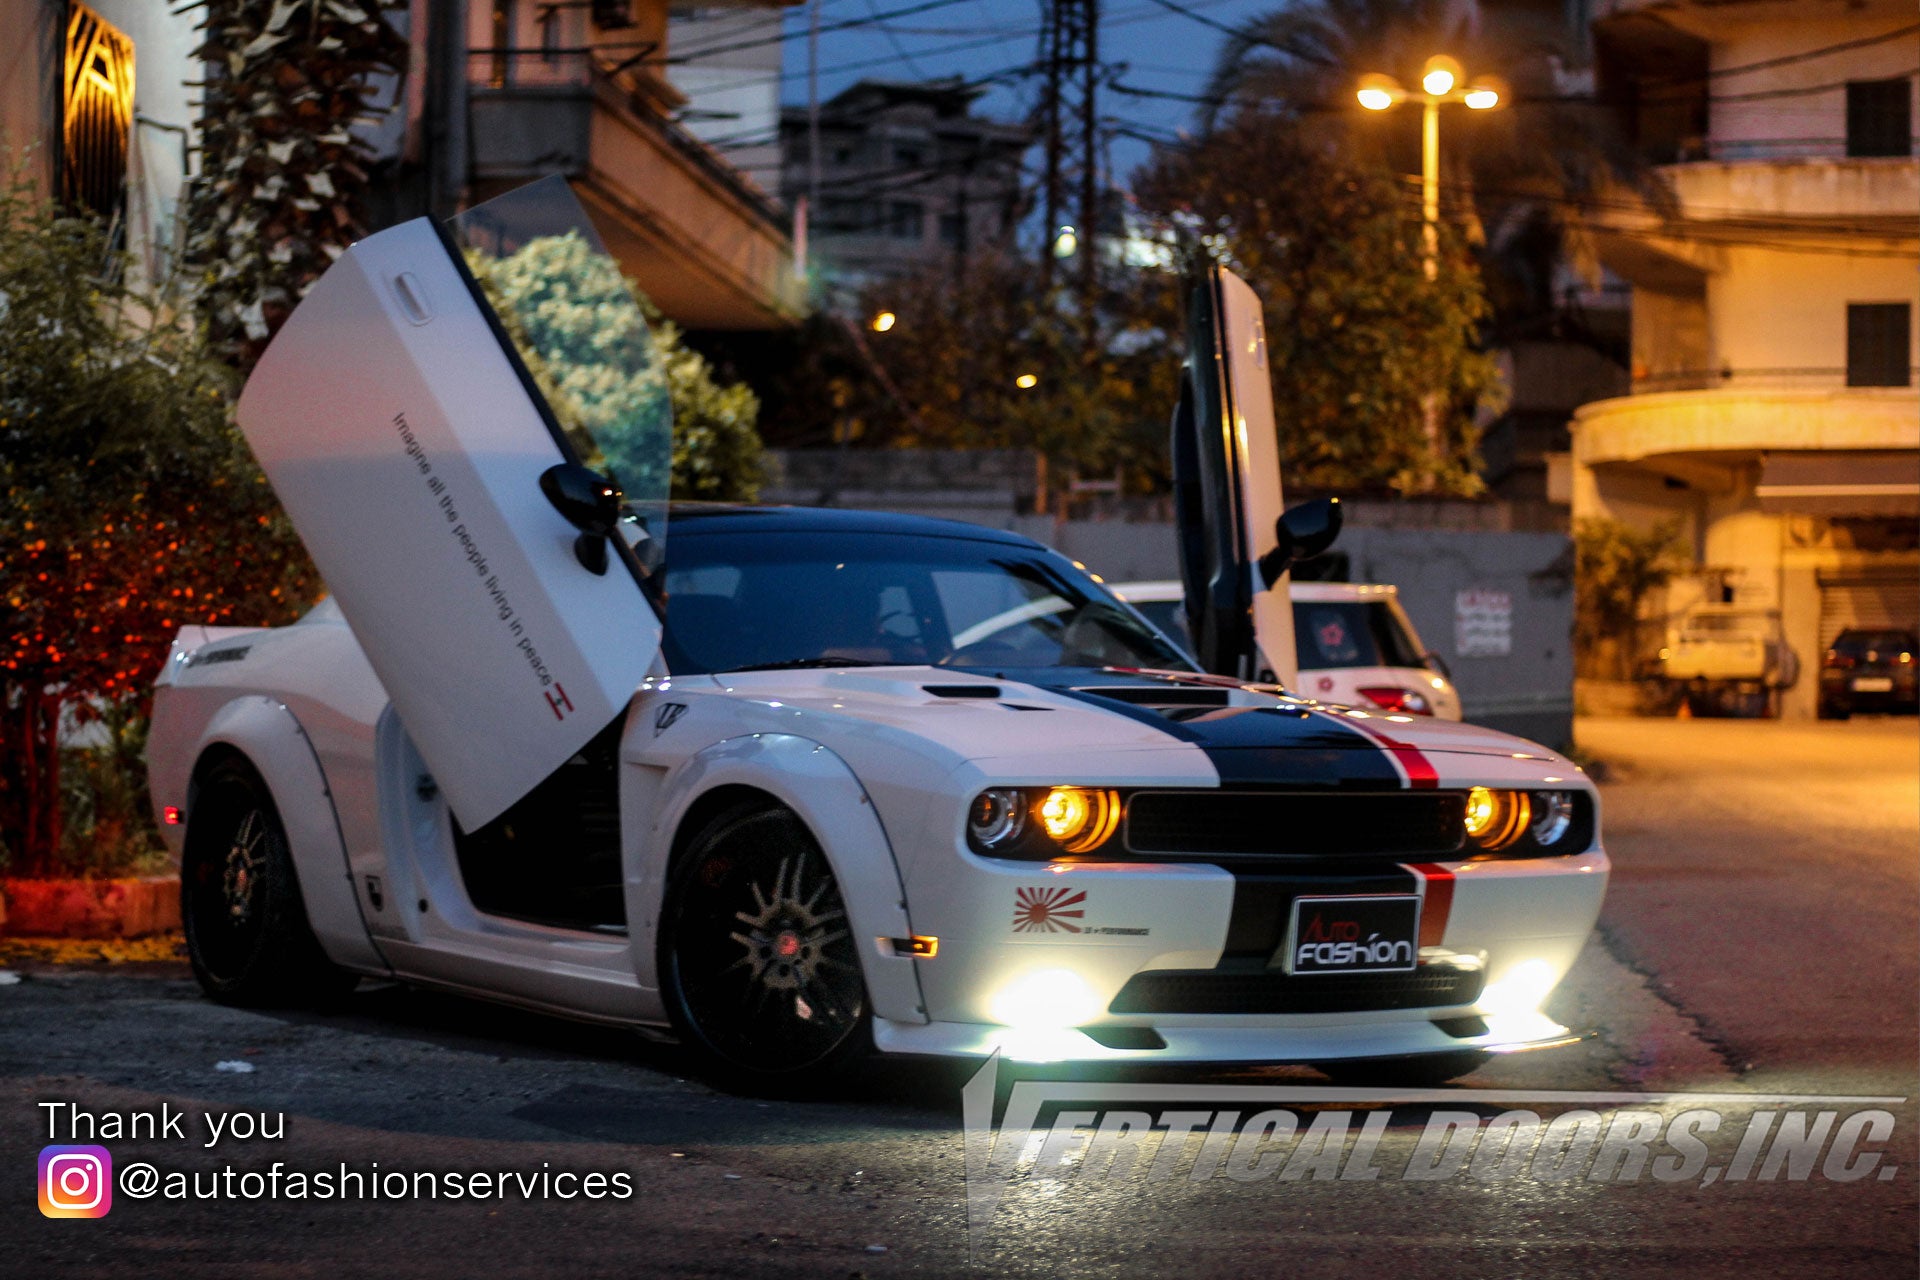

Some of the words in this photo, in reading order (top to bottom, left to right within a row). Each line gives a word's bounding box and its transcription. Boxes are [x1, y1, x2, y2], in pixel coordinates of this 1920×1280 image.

[393, 412, 430, 475] Imagine
[427, 476, 446, 497] all
[438, 494, 458, 523] the
[452, 524, 489, 577] people
[484, 575, 513, 621] living
[509, 618, 523, 637] in
[516, 637, 552, 686] peace
